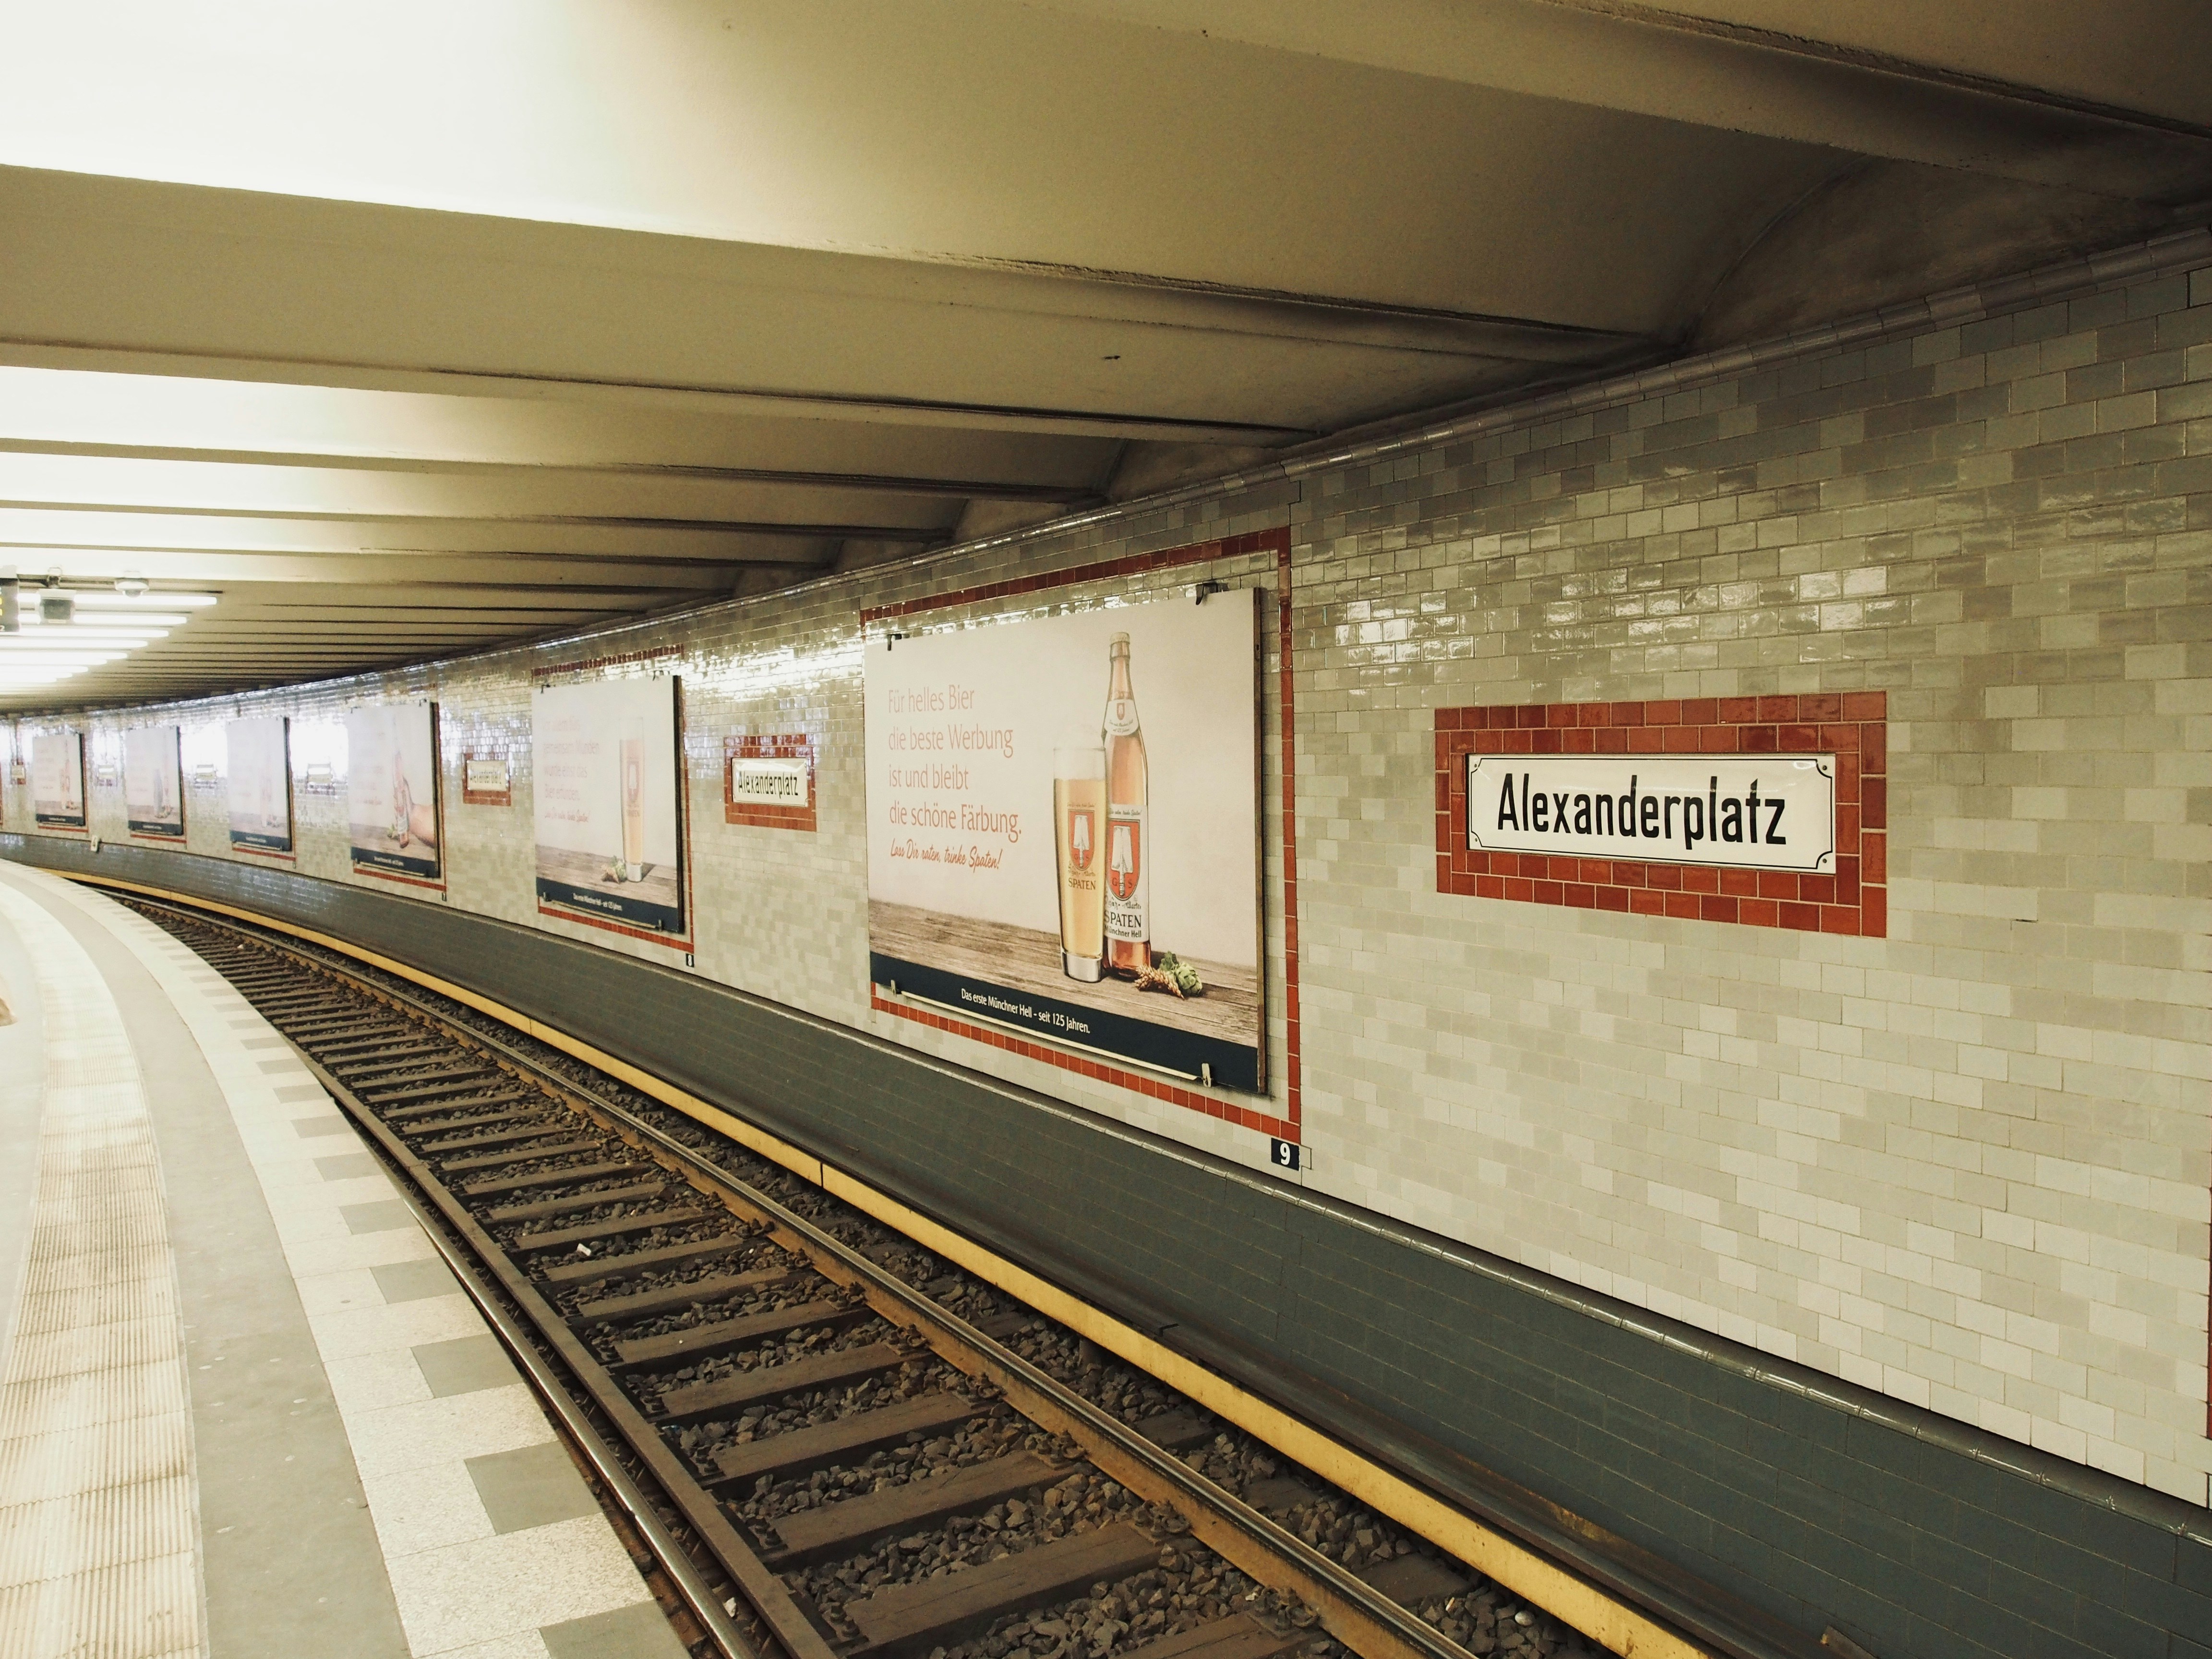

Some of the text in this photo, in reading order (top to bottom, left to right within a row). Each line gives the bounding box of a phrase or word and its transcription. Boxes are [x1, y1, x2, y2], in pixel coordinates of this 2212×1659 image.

[889, 684, 974, 713] Für helles Bier
[889, 723, 1013, 758] die beste Werbung
[738, 771, 798, 799] Alexanderplatz
[889, 764, 968, 790] ist und bleibt
[890, 800, 1021, 843] die schöne Färbung.
[1498, 773, 1787, 850] Alexanderplatz
[890, 838, 1003, 873] Lass Dir raten, trinke Spaten!
[1068, 878, 1096, 890] SPATEN
[1112, 878, 1132, 888] G S
[1104, 910, 1142, 928] SPATEN
[1104, 925, 1130, 938] Münchner
[688, 954, 692, 966] 8
[961, 988, 972, 1000] Das
[973, 993, 987, 1006] erste
[988, 997, 1018, 1014] Münchner
[1020, 1004, 1032, 1018] Hell
[1038, 1010, 1050, 1024] seit
[1053, 1014, 1065, 1027] 125
[1066, 1016, 1091, 1034] Jahren.
[1280, 1143, 1290, 1165] 9
